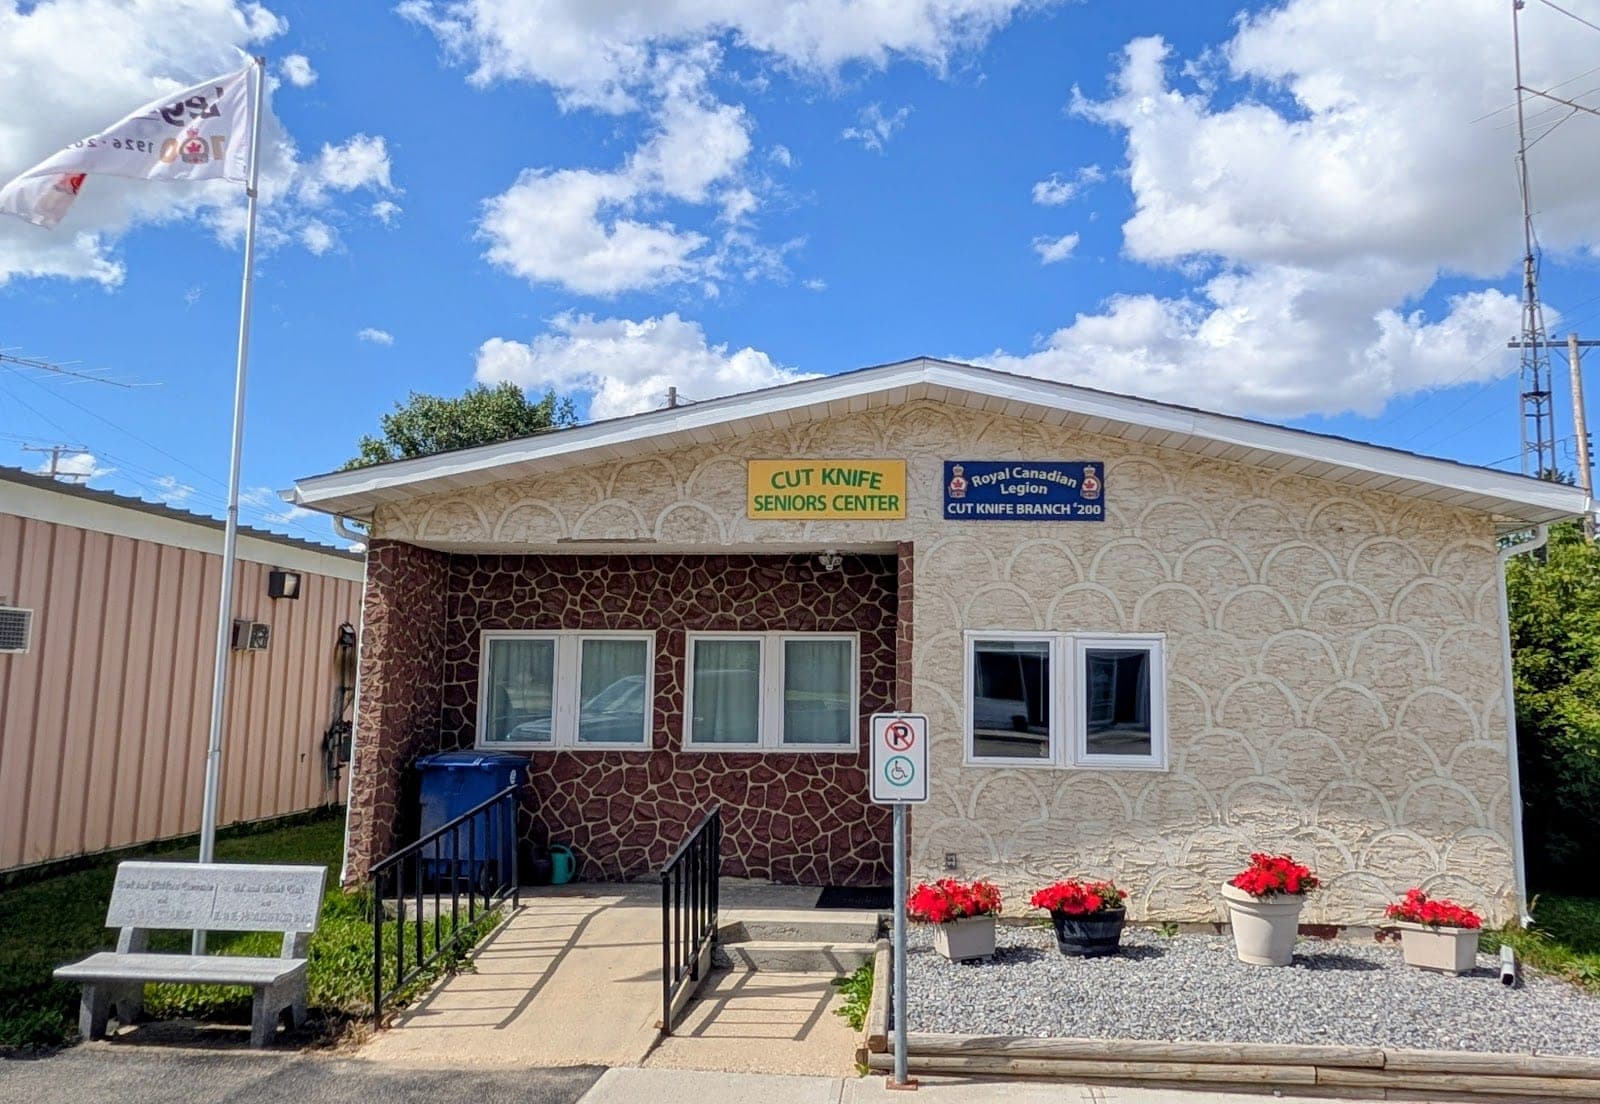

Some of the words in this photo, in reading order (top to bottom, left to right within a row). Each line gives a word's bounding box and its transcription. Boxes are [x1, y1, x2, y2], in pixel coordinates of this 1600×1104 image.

[771, 468, 814, 489] CUT
[821, 468, 883, 490] KNIFE
[971, 467, 1010, 487] Royal
[1012, 467, 1077, 488] Canadian
[1000, 482, 1048, 496] Legion
[754, 495, 827, 511] SENIORS
[832, 495, 899, 511] CENTER
[947, 503, 974, 514] CUT
[976, 503, 1014, 514] KNIFE
[1016, 504, 1070, 515] BRANCH
[893, 726, 908, 745] P
